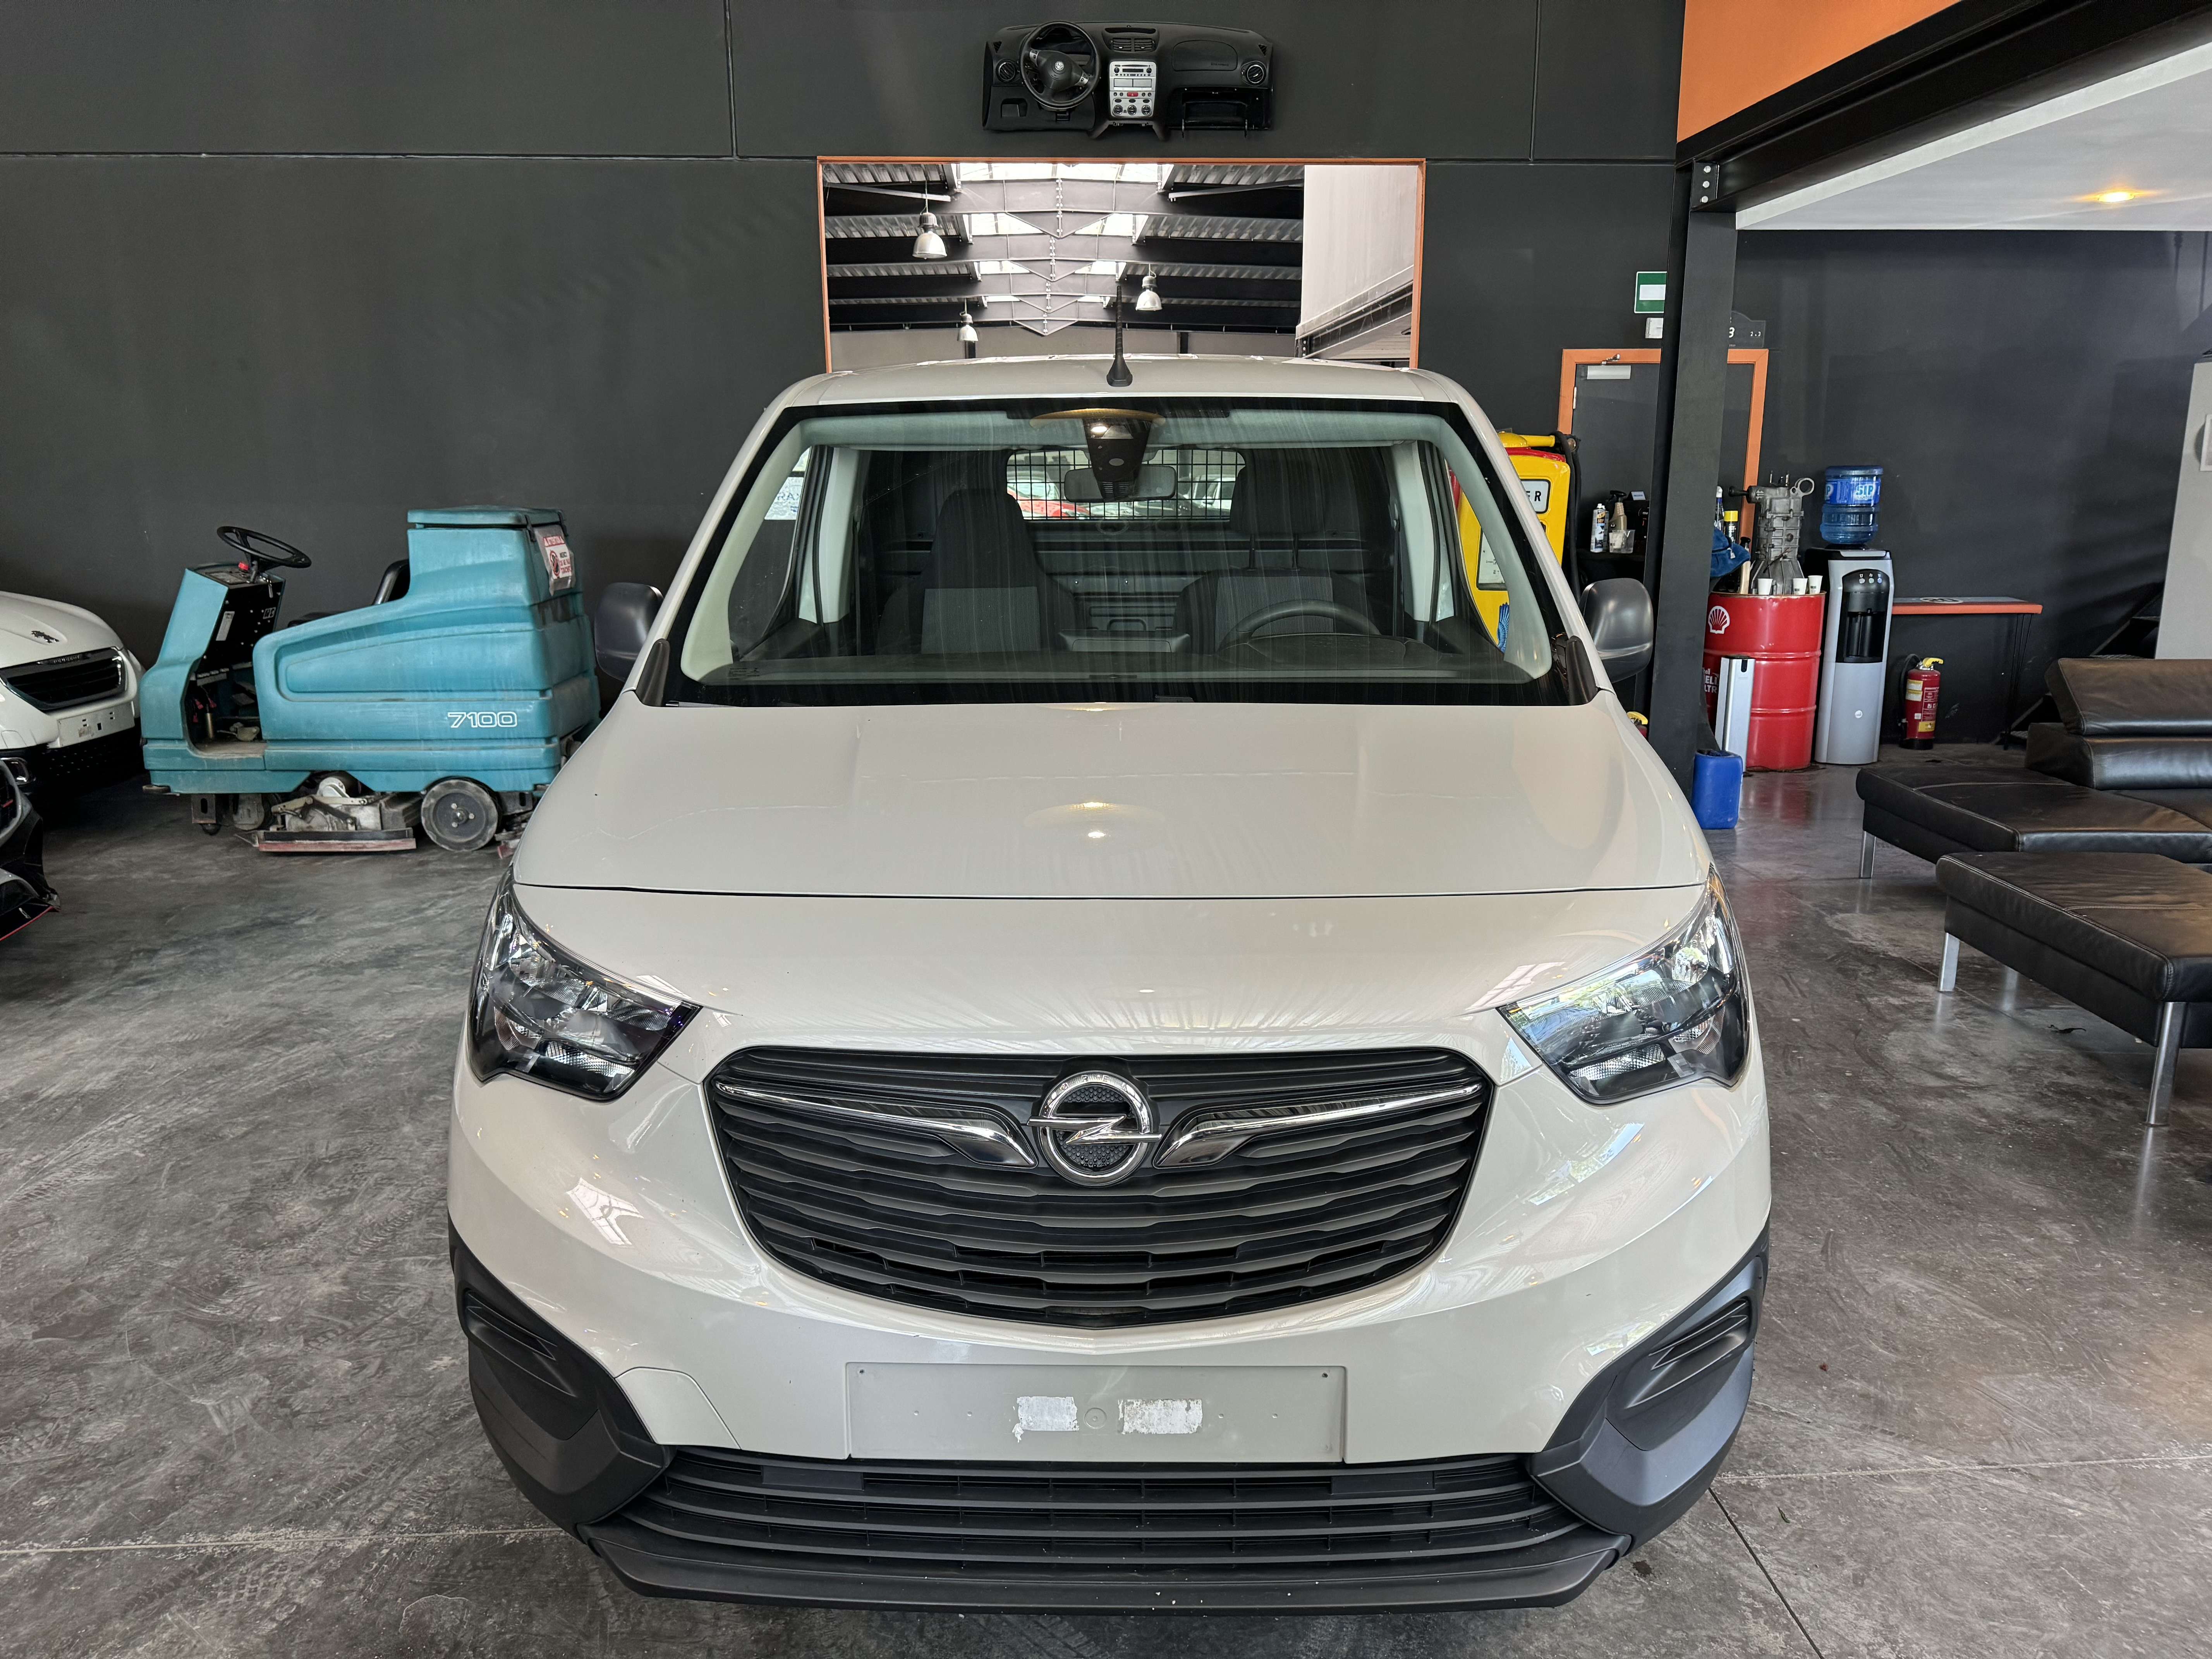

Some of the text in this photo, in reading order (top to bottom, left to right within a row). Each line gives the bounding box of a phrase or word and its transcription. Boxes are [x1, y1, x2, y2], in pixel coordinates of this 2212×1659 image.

[1855, 485, 1874, 495] SIP
[1704, 675, 1717, 685] ELI
[1704, 684, 1717, 693] LTR
[448, 711, 517, 728] 7100
